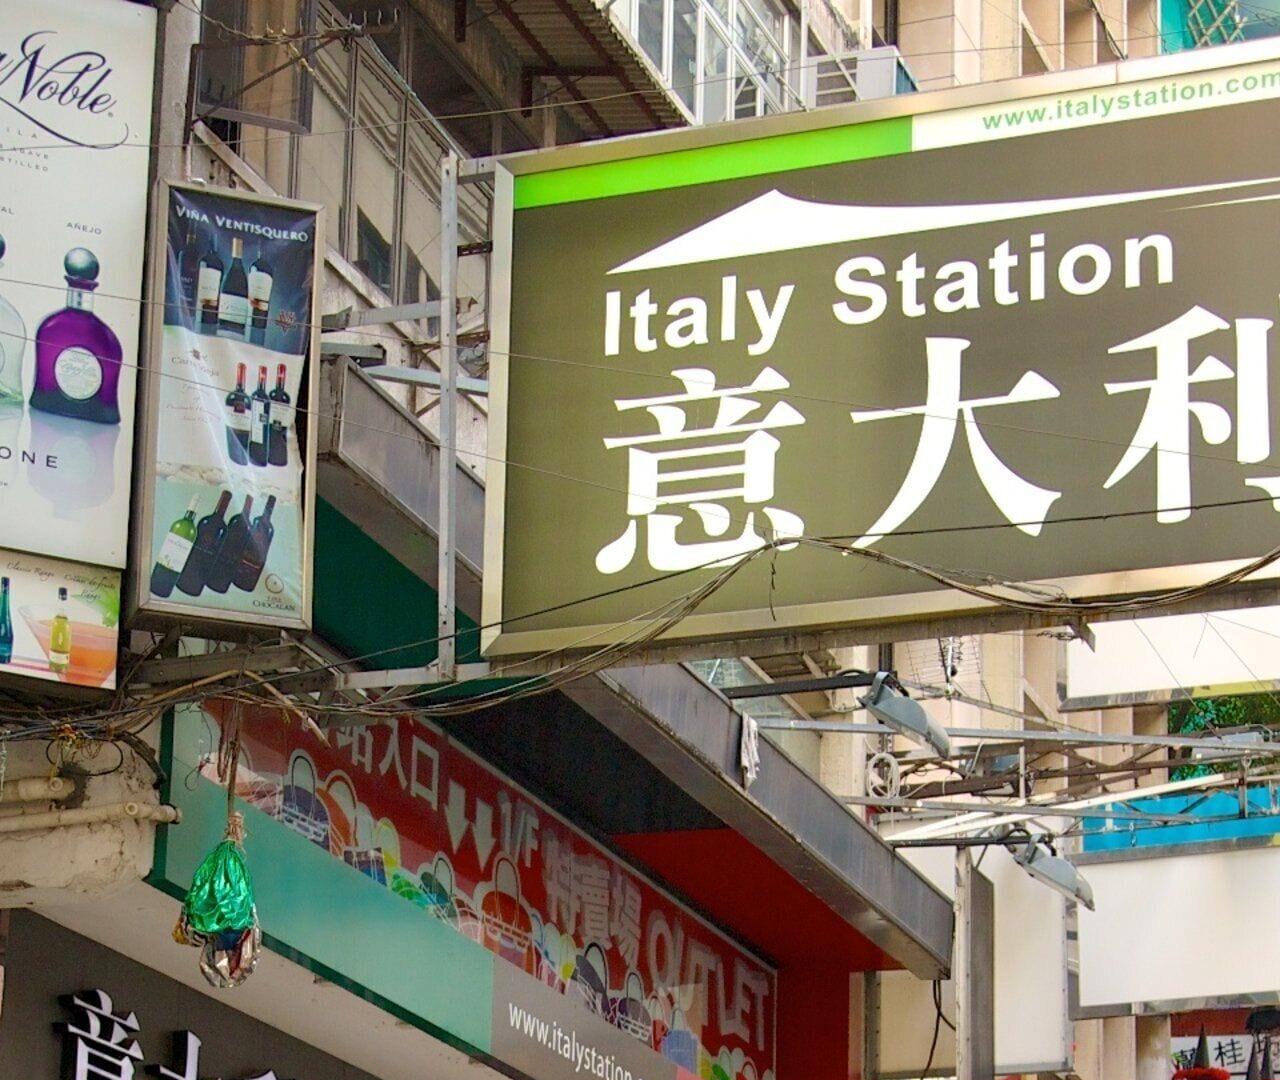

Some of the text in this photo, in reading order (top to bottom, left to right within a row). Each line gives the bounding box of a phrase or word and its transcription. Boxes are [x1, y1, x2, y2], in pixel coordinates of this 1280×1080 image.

[66, 221, 103, 236] AÑEJO
[176, 205, 309, 242] VIÑA VENTISQUERO
[602, 220, 1173, 360] Italy Station
[646, 908, 770, 1054] OUTLET
